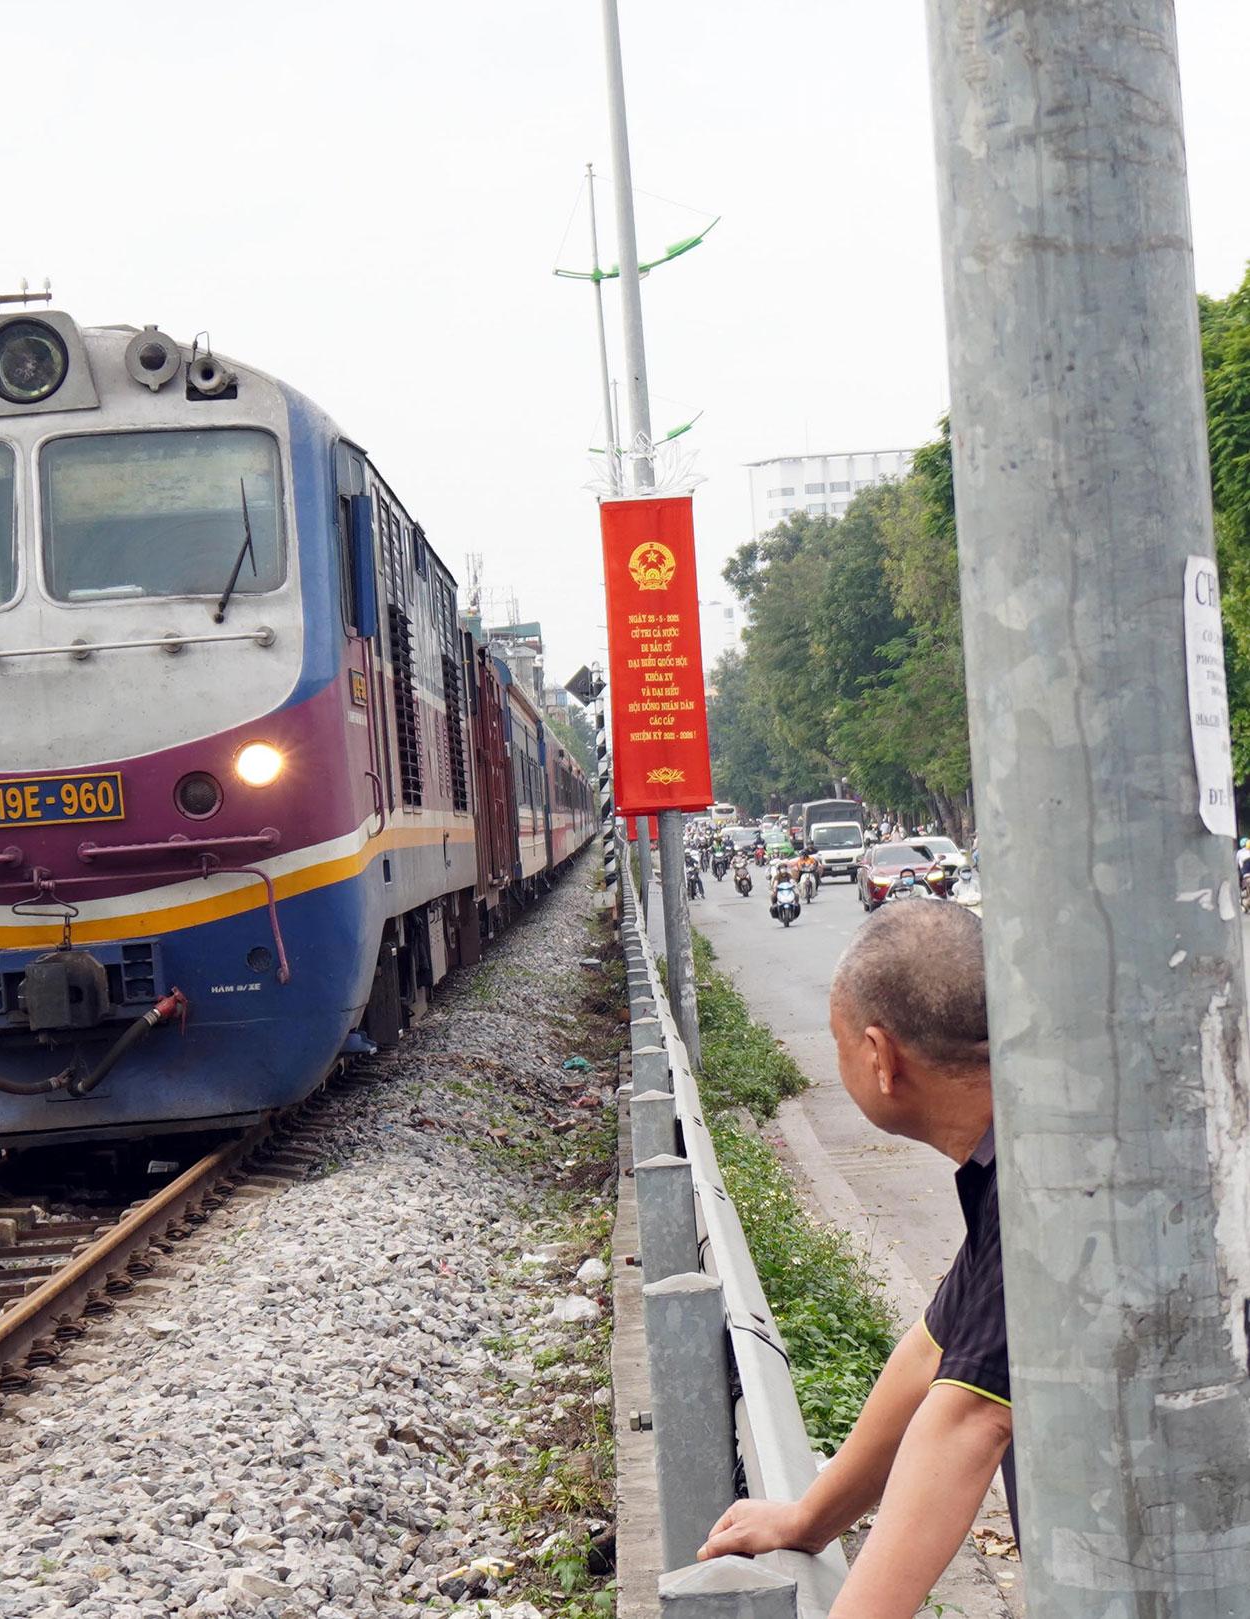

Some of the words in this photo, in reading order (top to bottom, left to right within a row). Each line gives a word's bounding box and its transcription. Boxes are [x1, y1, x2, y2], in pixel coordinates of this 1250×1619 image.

[628, 613, 647, 624] NGÀY
[641, 629, 652, 638] TRI
[662, 626, 680, 638] NƯỚC
[641, 643, 649, 653] ĐI
[628, 658, 640, 670] ĐẠI
[641, 653, 656, 667] BIỂU
[657, 654, 675, 667] QUỐC
[675, 655, 689, 668] HỘI
[645, 671, 664, 682] KHÓA
[664, 672, 674, 682] XV
[641, 685, 651, 697] VÀ
[651, 687, 664, 698] ĐẠI
[664, 682, 680, 695] BIỂU
[628, 700, 640, 713] HỘI
[641, 698, 660, 711] ĐỒNG
[661, 700, 679, 711] NHÂN
[680, 698, 695, 710] DÂN
[649, 714, 662, 726] CÁC
[663, 713, 675, 726] CẤP
[630, 729, 652, 743] NHIỆM
[652, 728, 662, 740] KỲ
